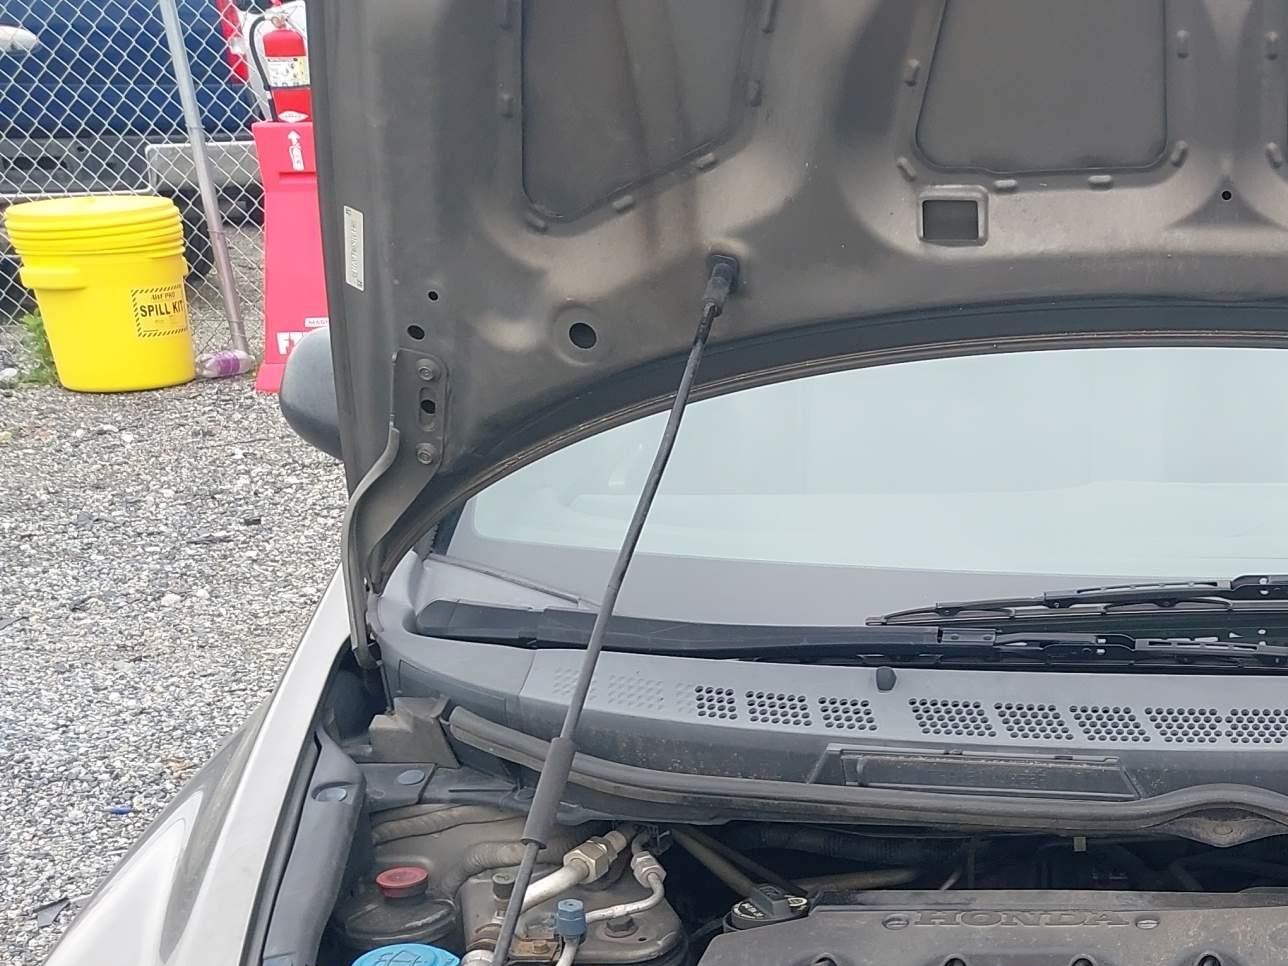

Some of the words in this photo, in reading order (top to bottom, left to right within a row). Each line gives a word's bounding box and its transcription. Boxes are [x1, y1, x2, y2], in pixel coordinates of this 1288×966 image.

[140, 303, 171, 317] SPILL
[172, 300, 186, 313] KIT
[914, 910, 1130, 927] HONDA
